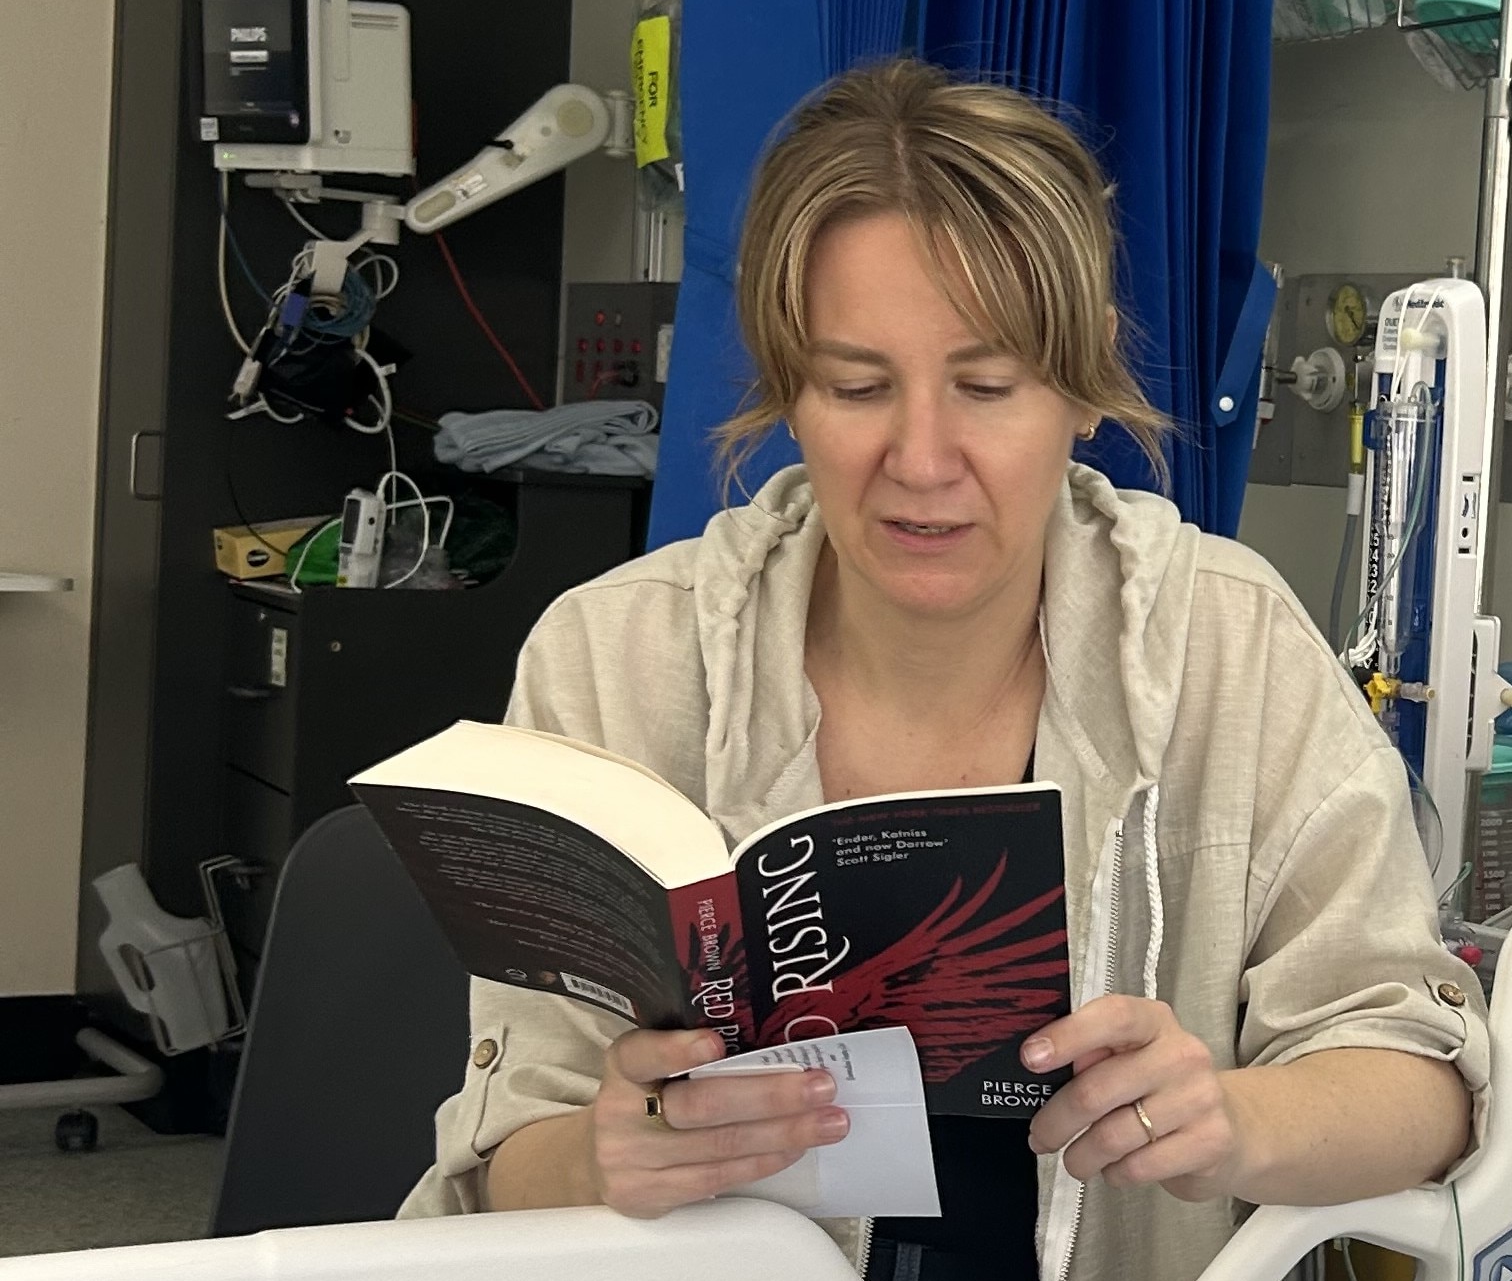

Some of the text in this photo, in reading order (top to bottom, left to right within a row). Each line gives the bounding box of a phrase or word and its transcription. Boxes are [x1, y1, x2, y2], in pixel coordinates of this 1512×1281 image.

[230, 28, 267, 42] PHILIPS
[648, 70, 659, 108] FOR
[881, 828, 928, 839] Katniss
[835, 845, 861, 857] and
[865, 843, 892, 852] now
[836, 851, 910, 867] Scott Sigler
[757, 834, 851, 1003] RISING
[697, 897, 722, 972] PIERCE BROWN
[691, 977, 735, 1019] RED
[983, 1080, 1052, 1096] PIERCE
